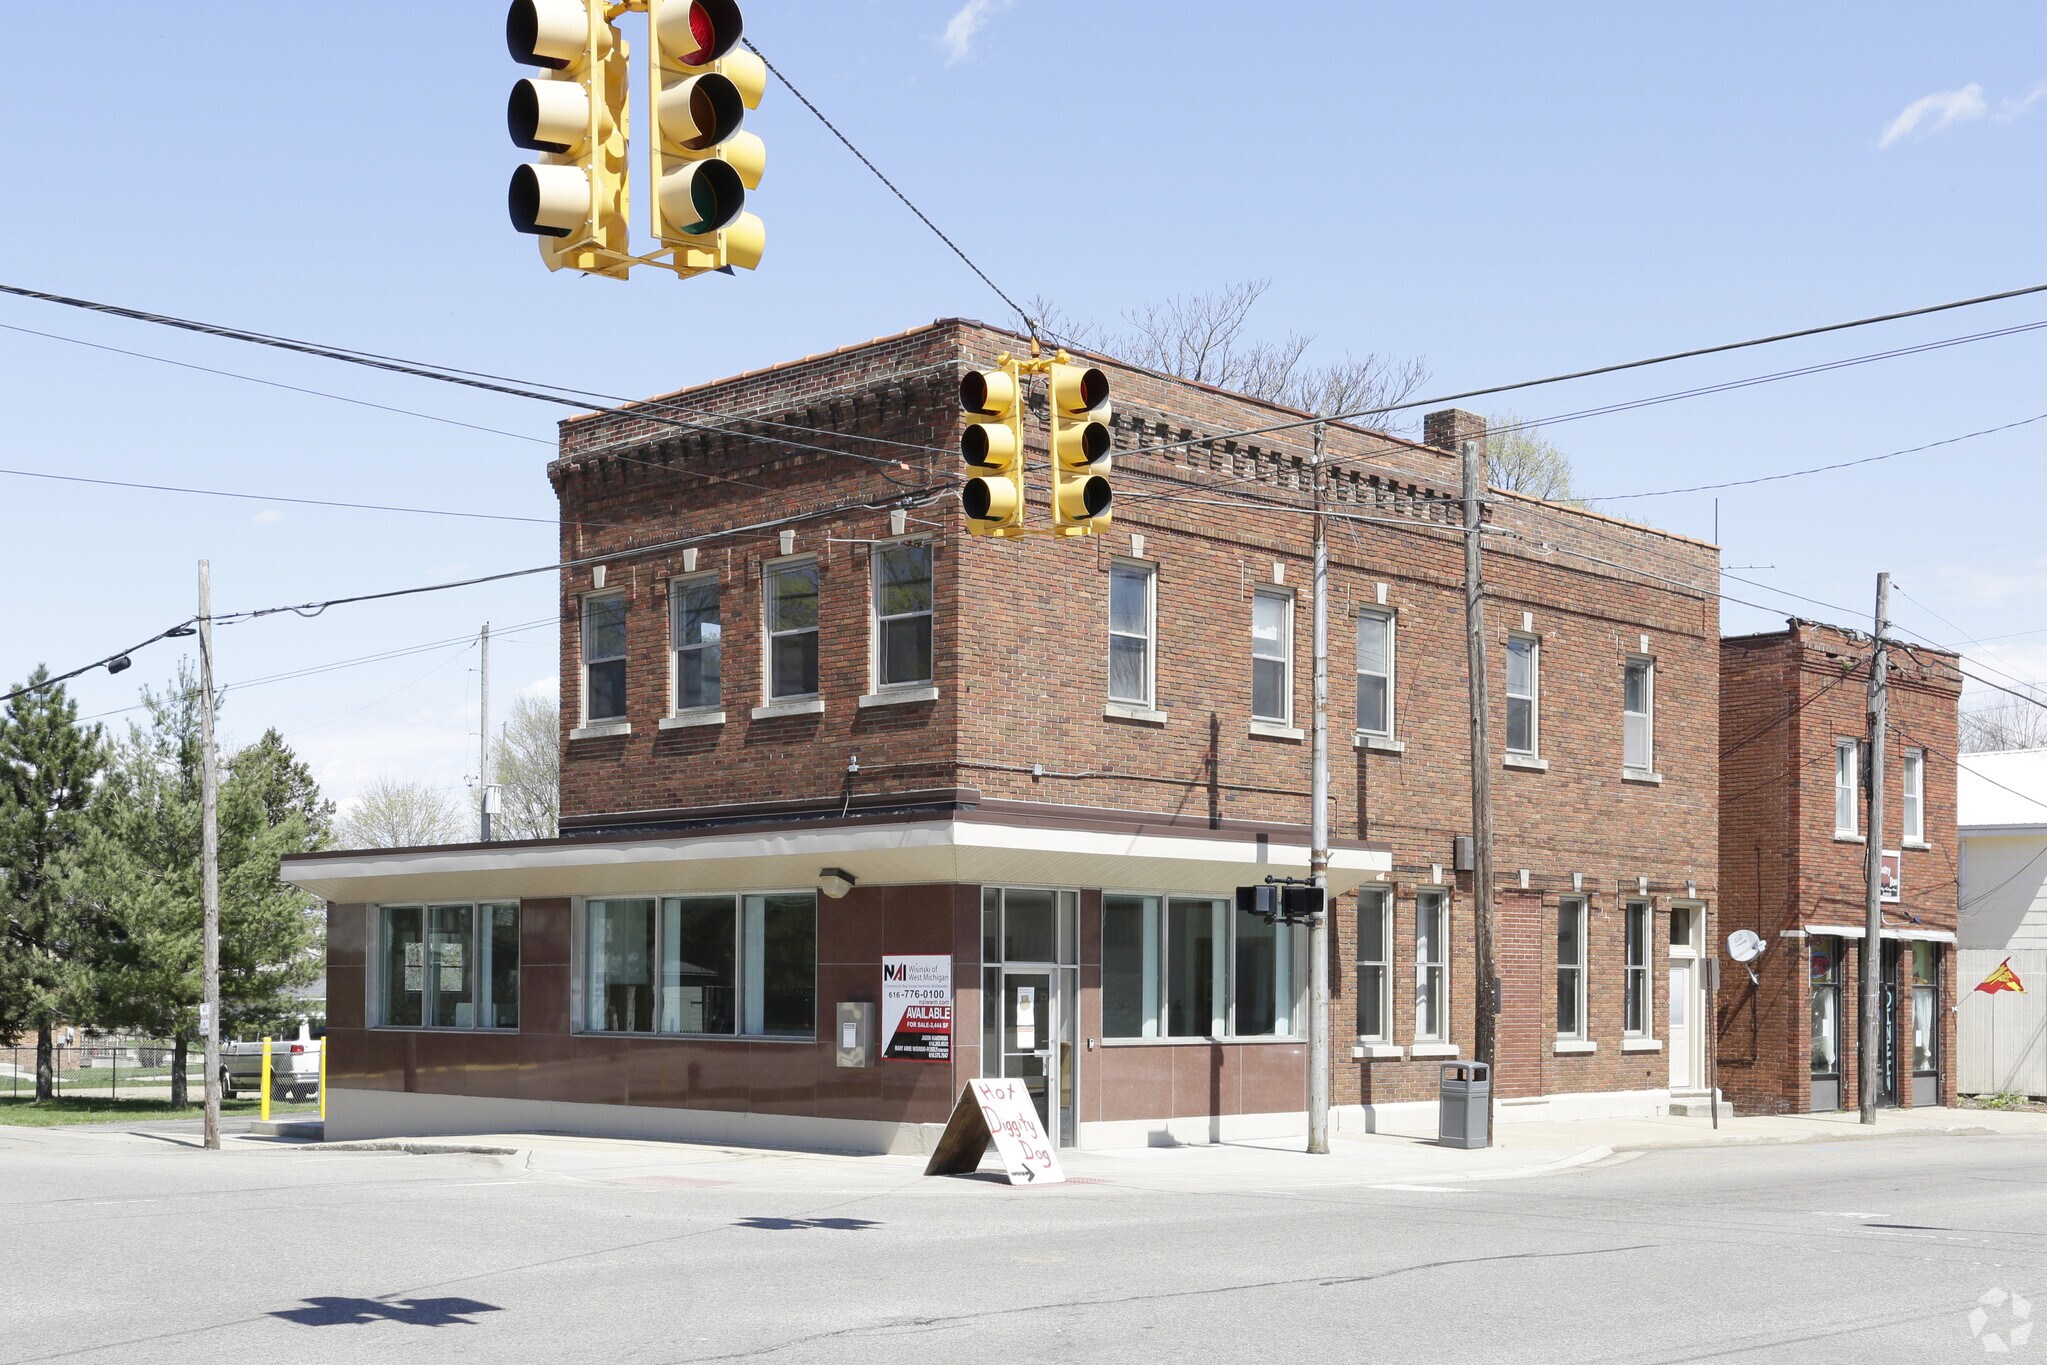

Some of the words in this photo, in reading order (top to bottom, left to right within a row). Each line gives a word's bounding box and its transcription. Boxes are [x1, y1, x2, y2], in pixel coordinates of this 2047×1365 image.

[884, 962, 906, 981] NAI
[909, 965, 930, 973] Wisinski
[932, 965, 938, 973] of
[923, 974, 949, 983] Michigan
[906, 1006, 951, 1020] AVAILABLE
[982, 1105, 1038, 1140] Diggity
[1019, 1139, 1052, 1169] Dog
